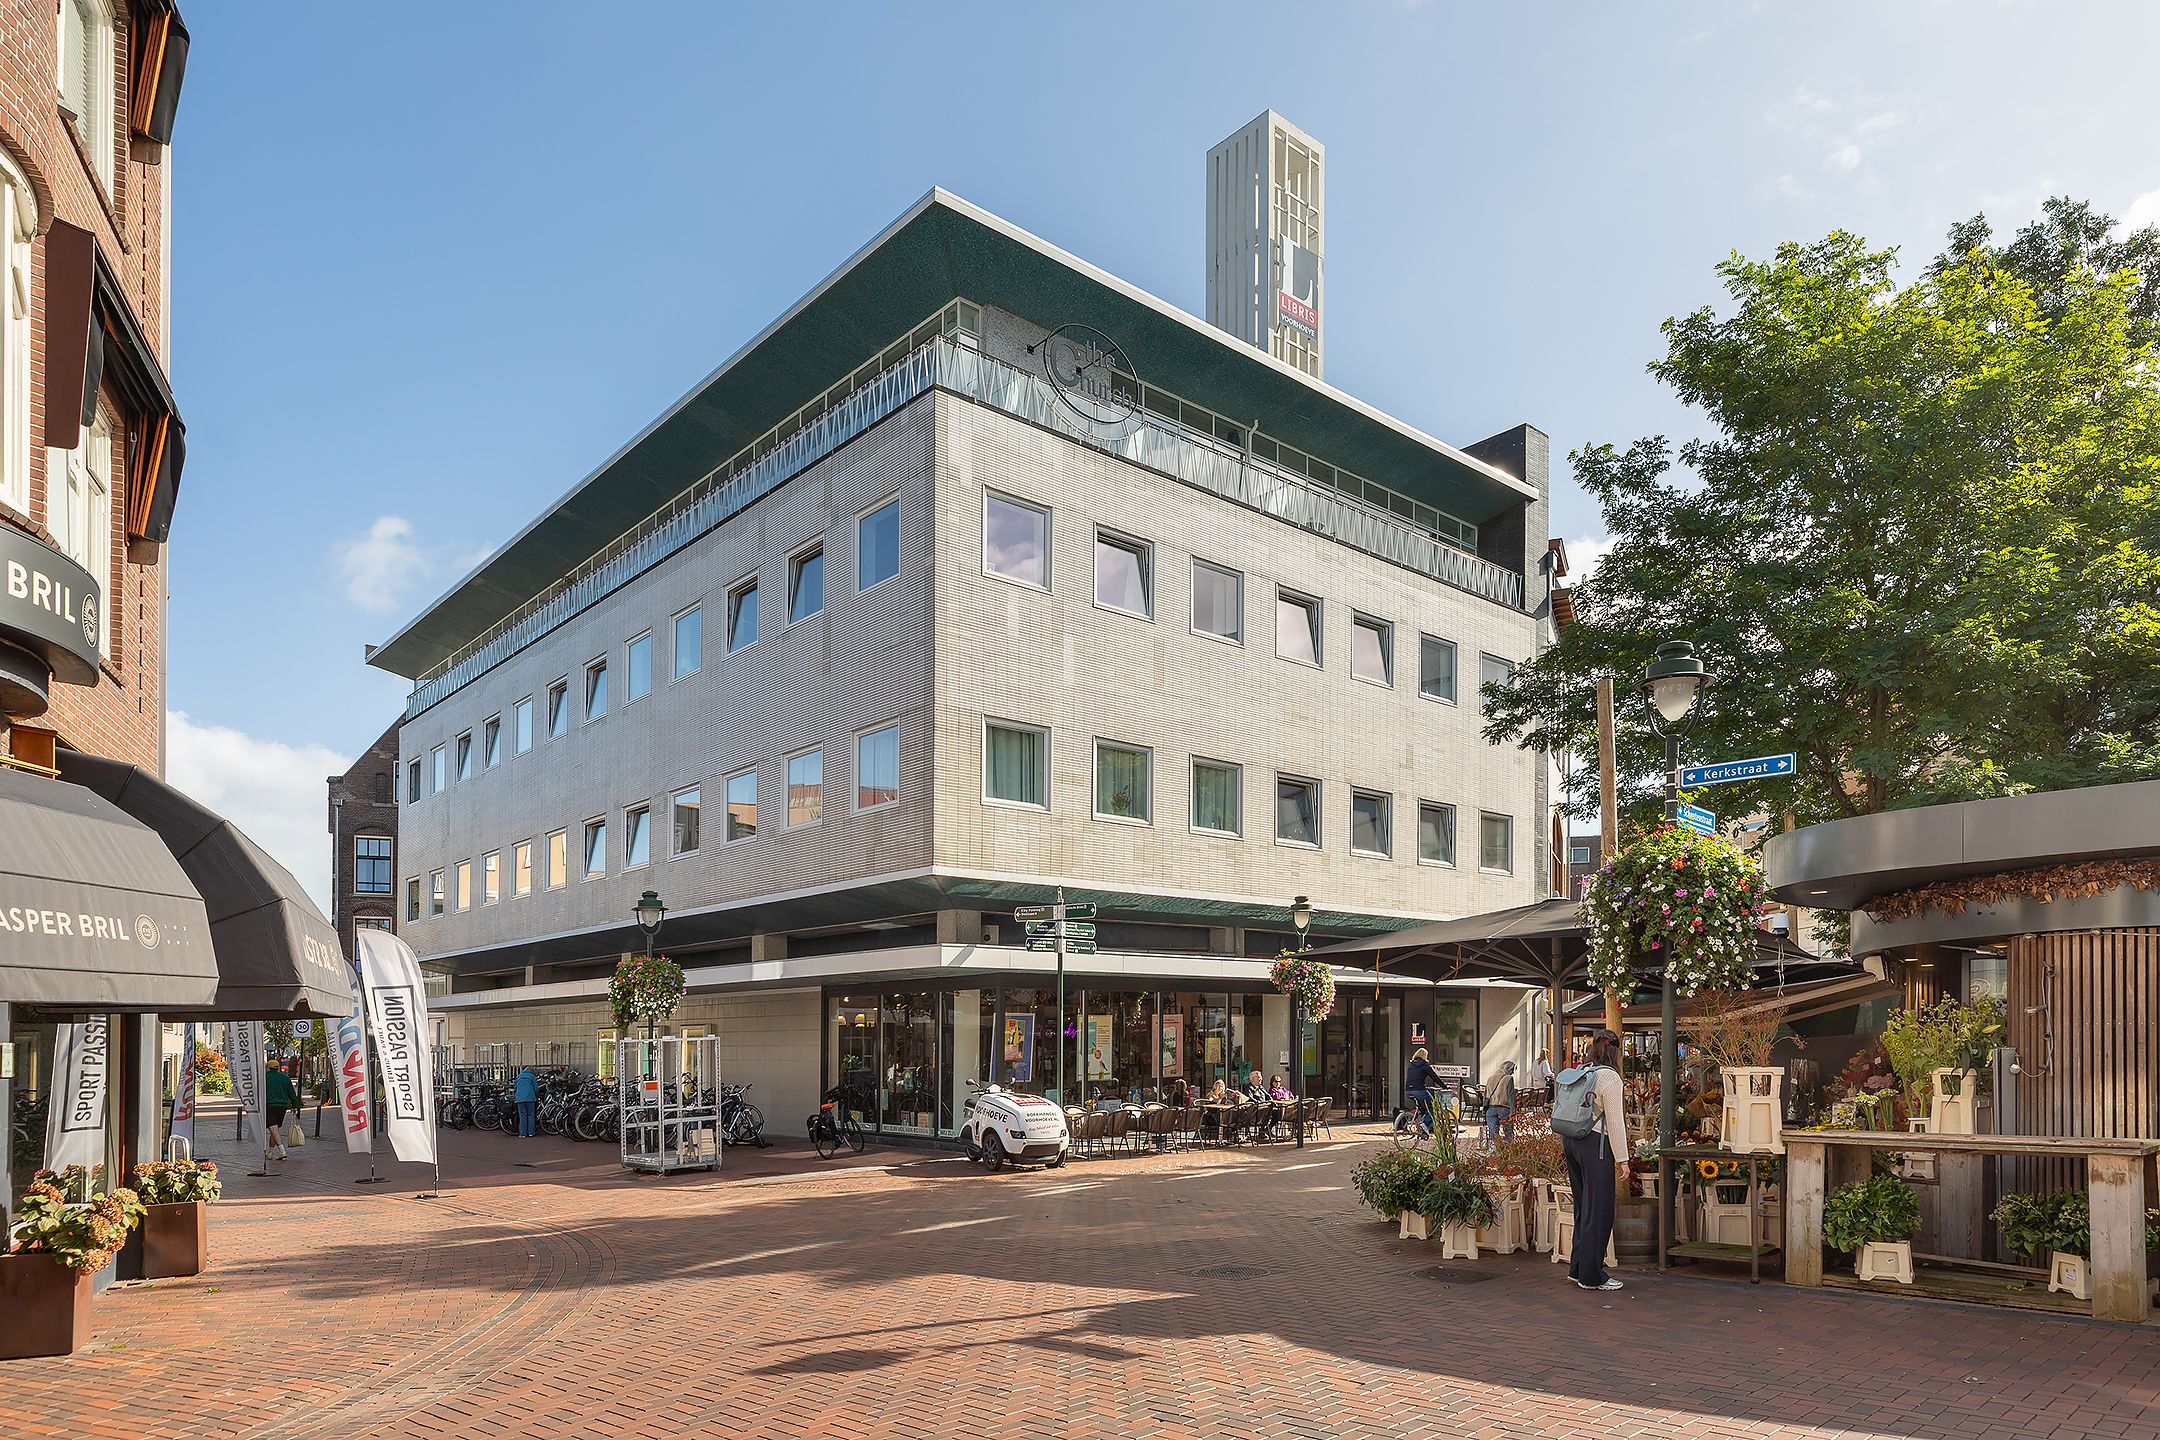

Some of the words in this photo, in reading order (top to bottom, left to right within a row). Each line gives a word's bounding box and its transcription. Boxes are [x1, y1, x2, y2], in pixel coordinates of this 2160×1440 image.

[1281, 295, 1315, 324] LIBRIS
[1280, 312, 1316, 337] VOORHOEVE
[7, 559, 76, 624] BRIL
[1703, 762, 1768, 780] Kerkstraat
[79, 914, 130, 941] BRIL
[82, 1013, 107, 1066] PASSI
[74, 1070, 101, 1122] SPORT
